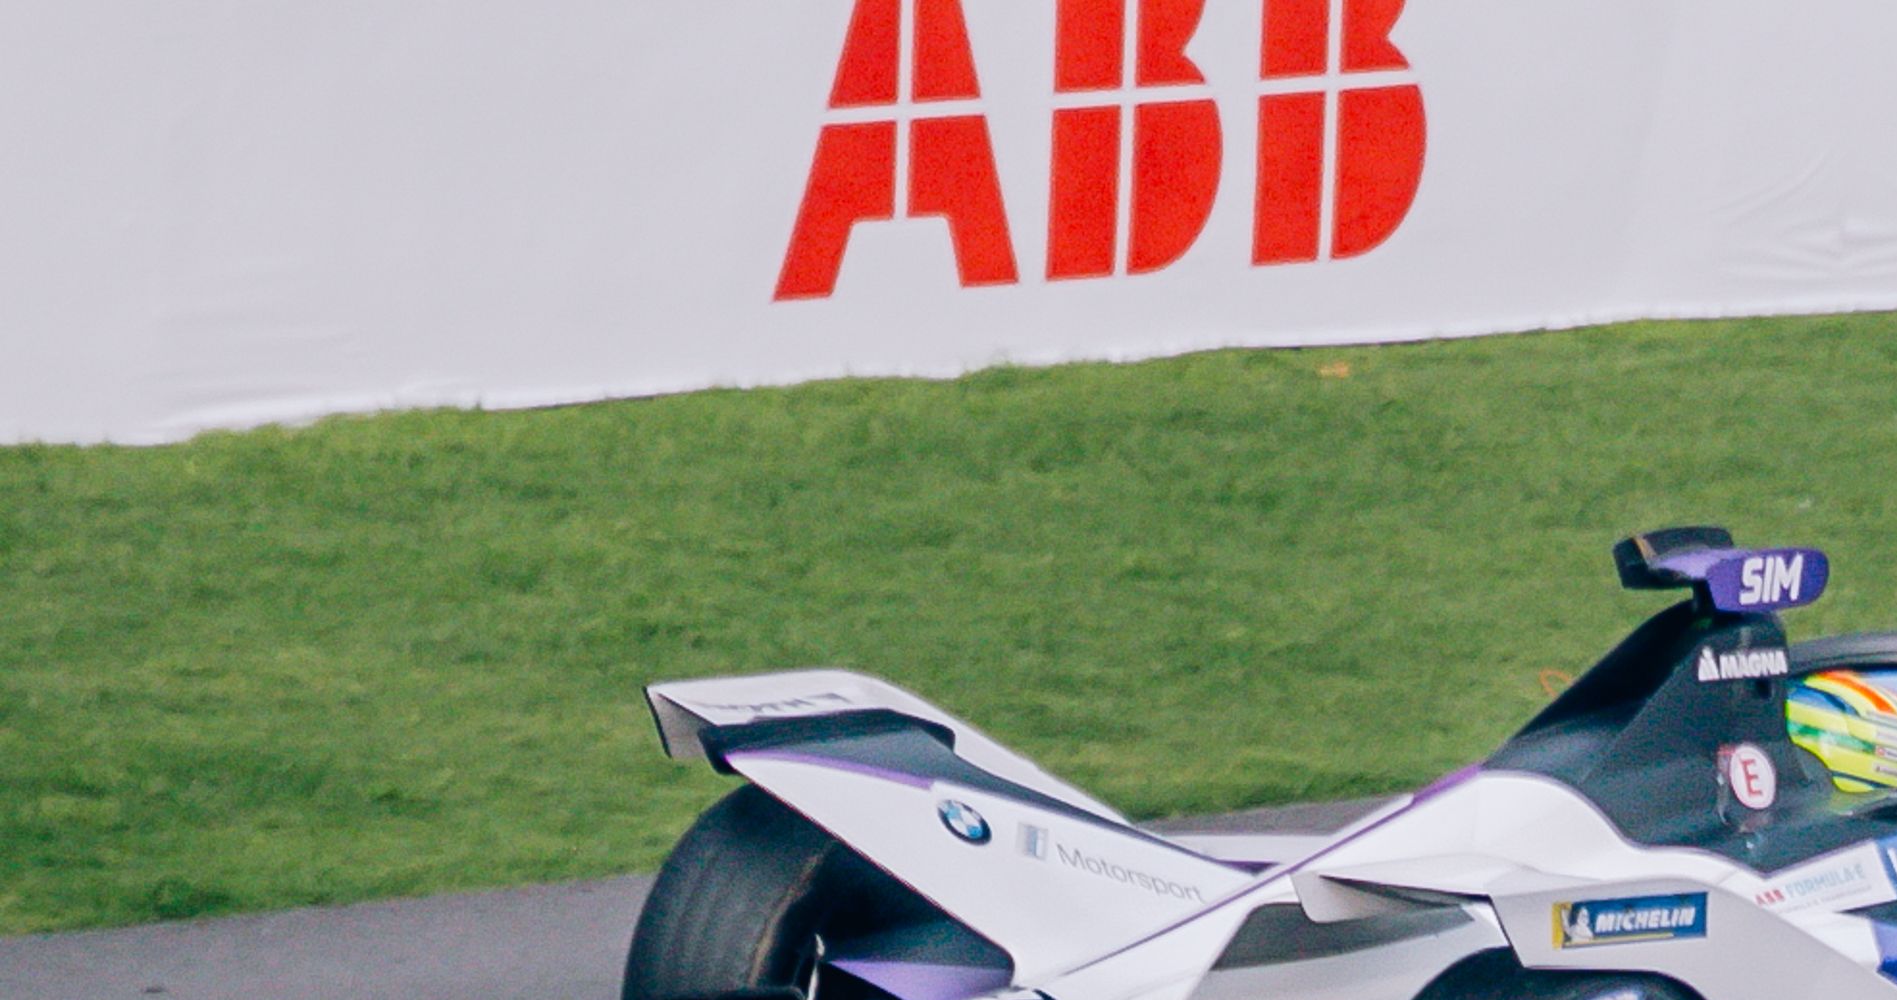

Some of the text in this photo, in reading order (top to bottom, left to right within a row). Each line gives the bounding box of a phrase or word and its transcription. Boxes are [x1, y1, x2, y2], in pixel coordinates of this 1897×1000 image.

[773, 0, 1427, 302] ABB
[1739, 553, 1803, 605] SIM
[1719, 650, 1787, 679] MAGNA
[1740, 758, 1762, 796] E
[1056, 842, 1204, 904] Motorsport
[1595, 906, 1696, 933] MICHELIN
